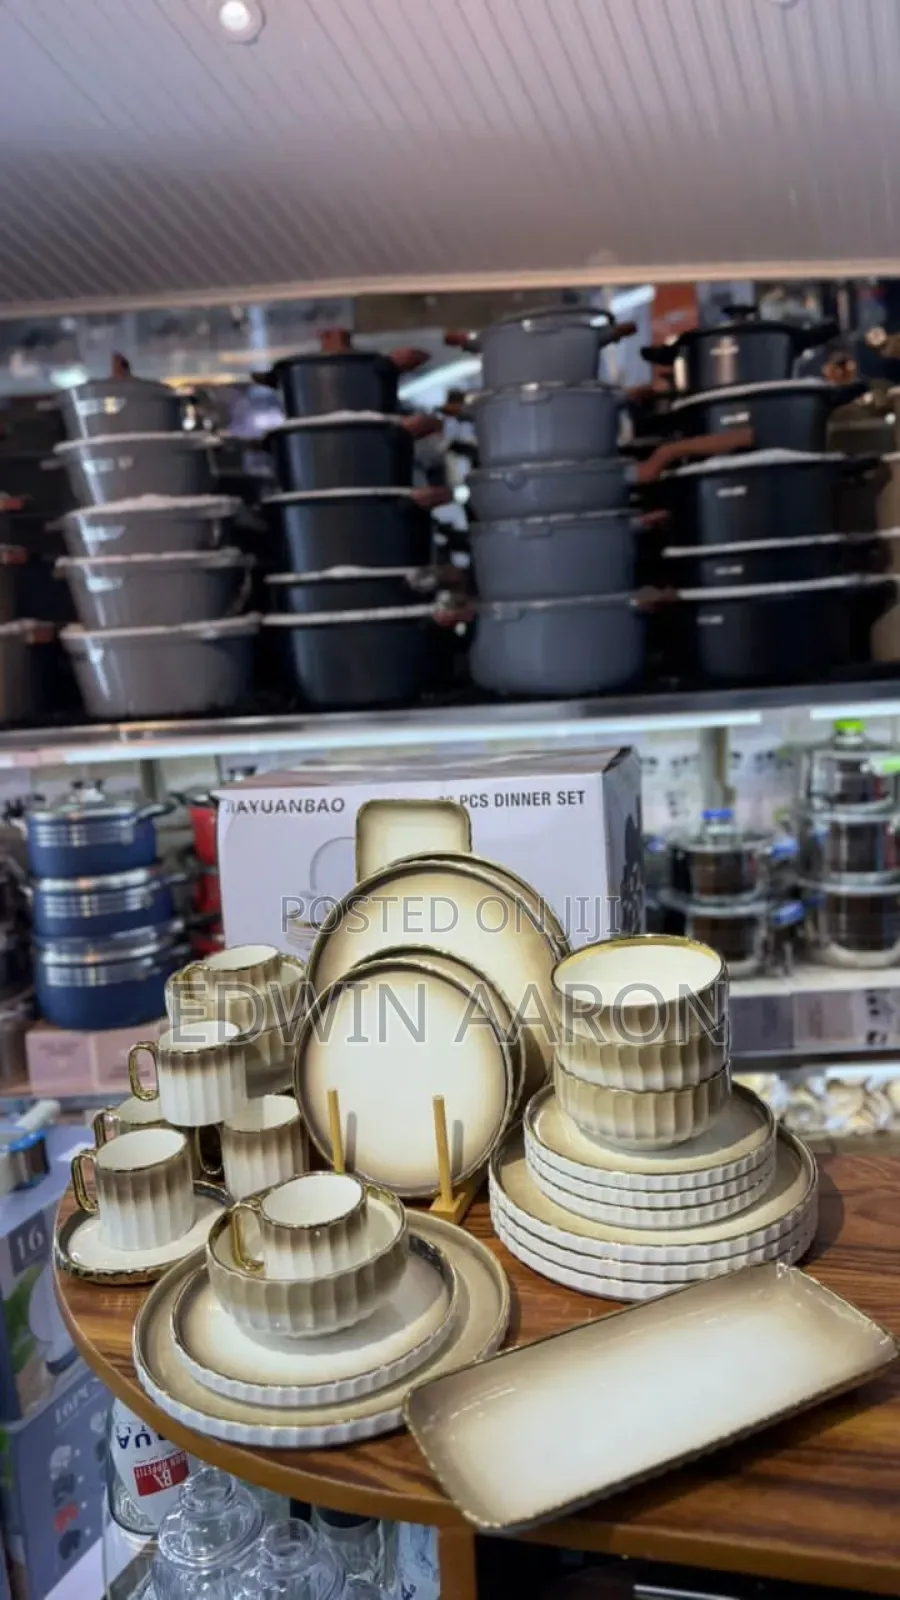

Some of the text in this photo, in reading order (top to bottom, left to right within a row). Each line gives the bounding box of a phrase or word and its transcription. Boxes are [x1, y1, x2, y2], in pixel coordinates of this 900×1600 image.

[460, 790, 585, 808] PCS DINNER SET
[17, 1227, 43, 1261] 16
